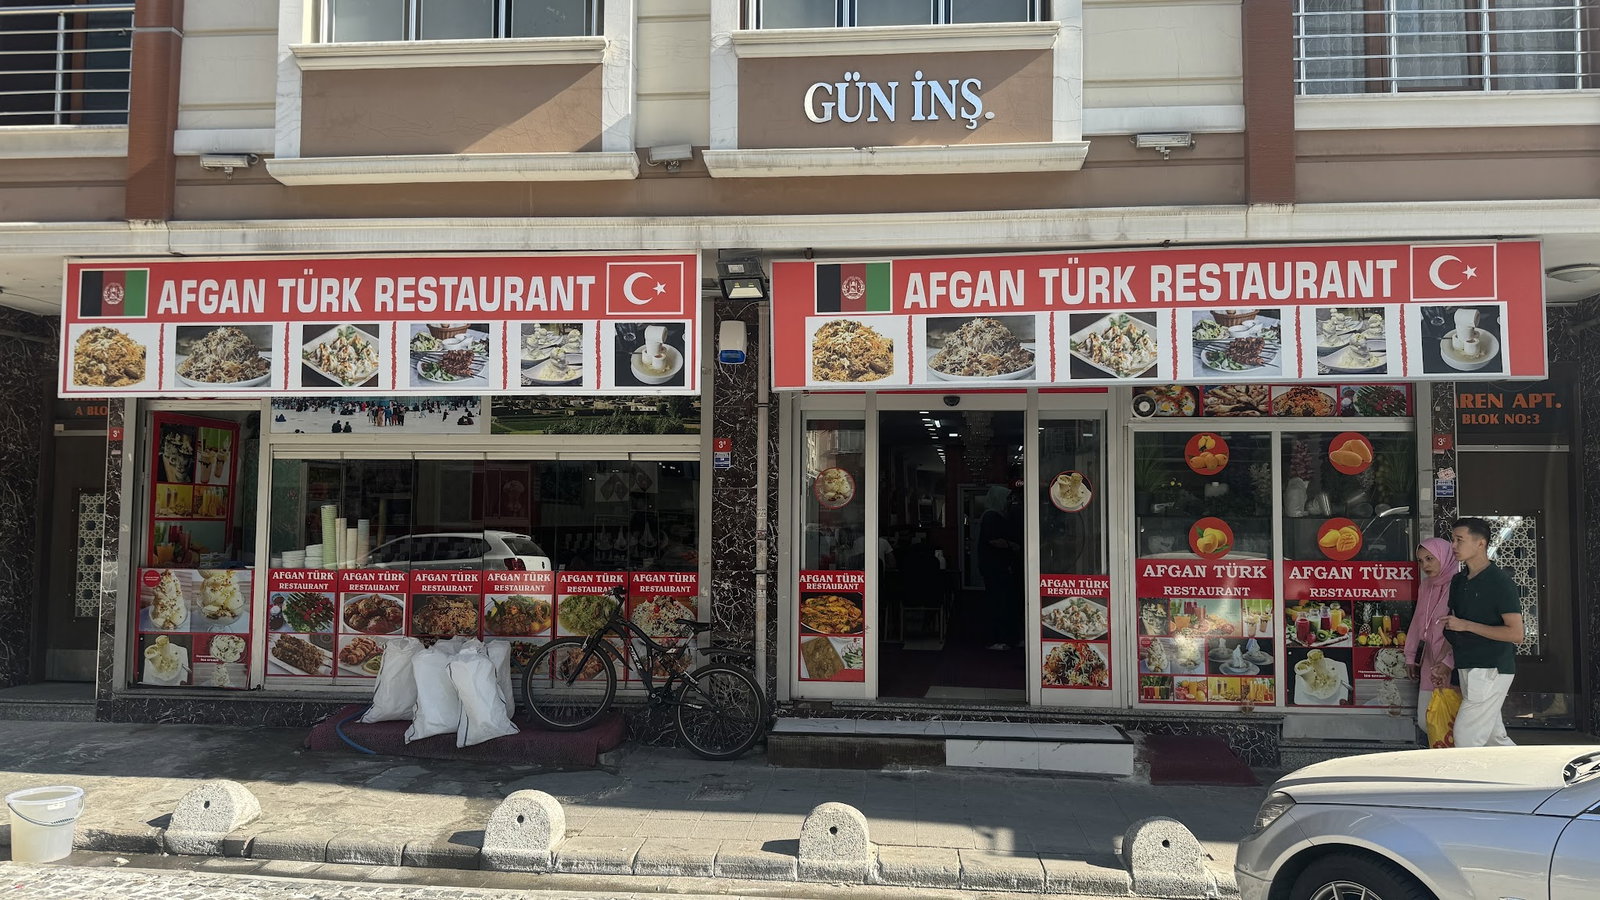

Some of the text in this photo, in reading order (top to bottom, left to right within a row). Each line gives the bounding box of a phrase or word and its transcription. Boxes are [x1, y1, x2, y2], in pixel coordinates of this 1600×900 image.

[804, 70, 996, 130] GÜN İNŞ.
[903, 257, 1398, 309] AFGAN TÜRK RESTAURANT
[157, 268, 596, 315] AFGAN TÜRK RESTAURANT
[1456, 392, 1562, 409] REN APT.
[75, 405, 108, 416] A BLO
[1462, 413, 1540, 425] BLOK NO:3
[272, 570, 334, 580] AFGAN TÜRK
[342, 571, 405, 581] AFGAN TÜRK
[1143, 562, 1267, 579] AFGAN TÜRK
[1289, 564, 1414, 580] AFGAN TÜRK
[415, 571, 478, 582] AFGAN TÜRK
[487, 572, 551, 582] AFGAN TÜRK
[560, 572, 624, 583] AFGAN TÜRK
[632, 572, 697, 583] AFGAN TÜRK
[799, 572, 865, 583] AFGAN TÜRK
[279, 582, 329, 590] RESTAURANT
[349, 583, 400, 591] RESTAURANT
[421, 584, 473, 592] RESTAURANT
[494, 584, 546, 592] RESTAURANT
[1040, 577, 1109, 589] AFGAN TÜRK
[640, 585, 691, 593] RESTAURANT
[1047, 588, 1103, 596] RESTAURANT
[1163, 586, 1251, 596] RESTAURANT
[1309, 587, 1398, 598] RESTAURANT
